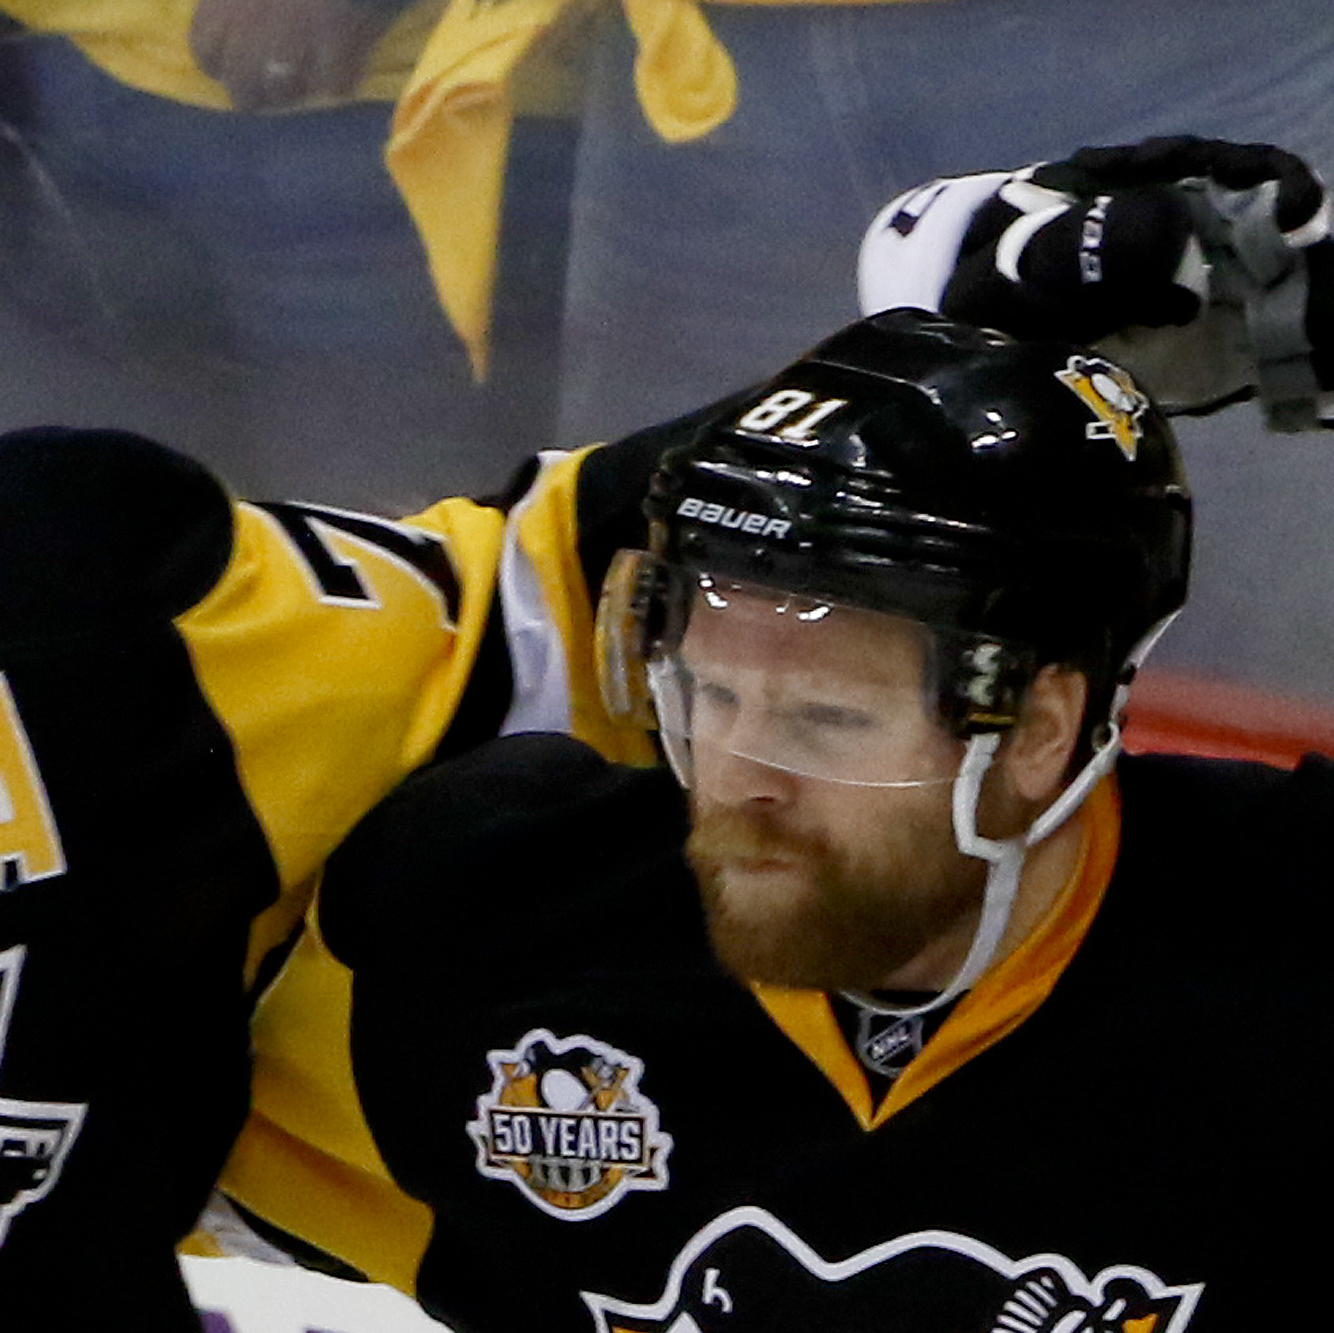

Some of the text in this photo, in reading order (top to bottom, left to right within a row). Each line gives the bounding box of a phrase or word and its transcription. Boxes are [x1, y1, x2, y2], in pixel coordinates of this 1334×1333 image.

[736, 386, 849, 440] 81
[677, 498, 793, 539] BAUER
[492, 1113, 642, 1160] 50 YEARS
